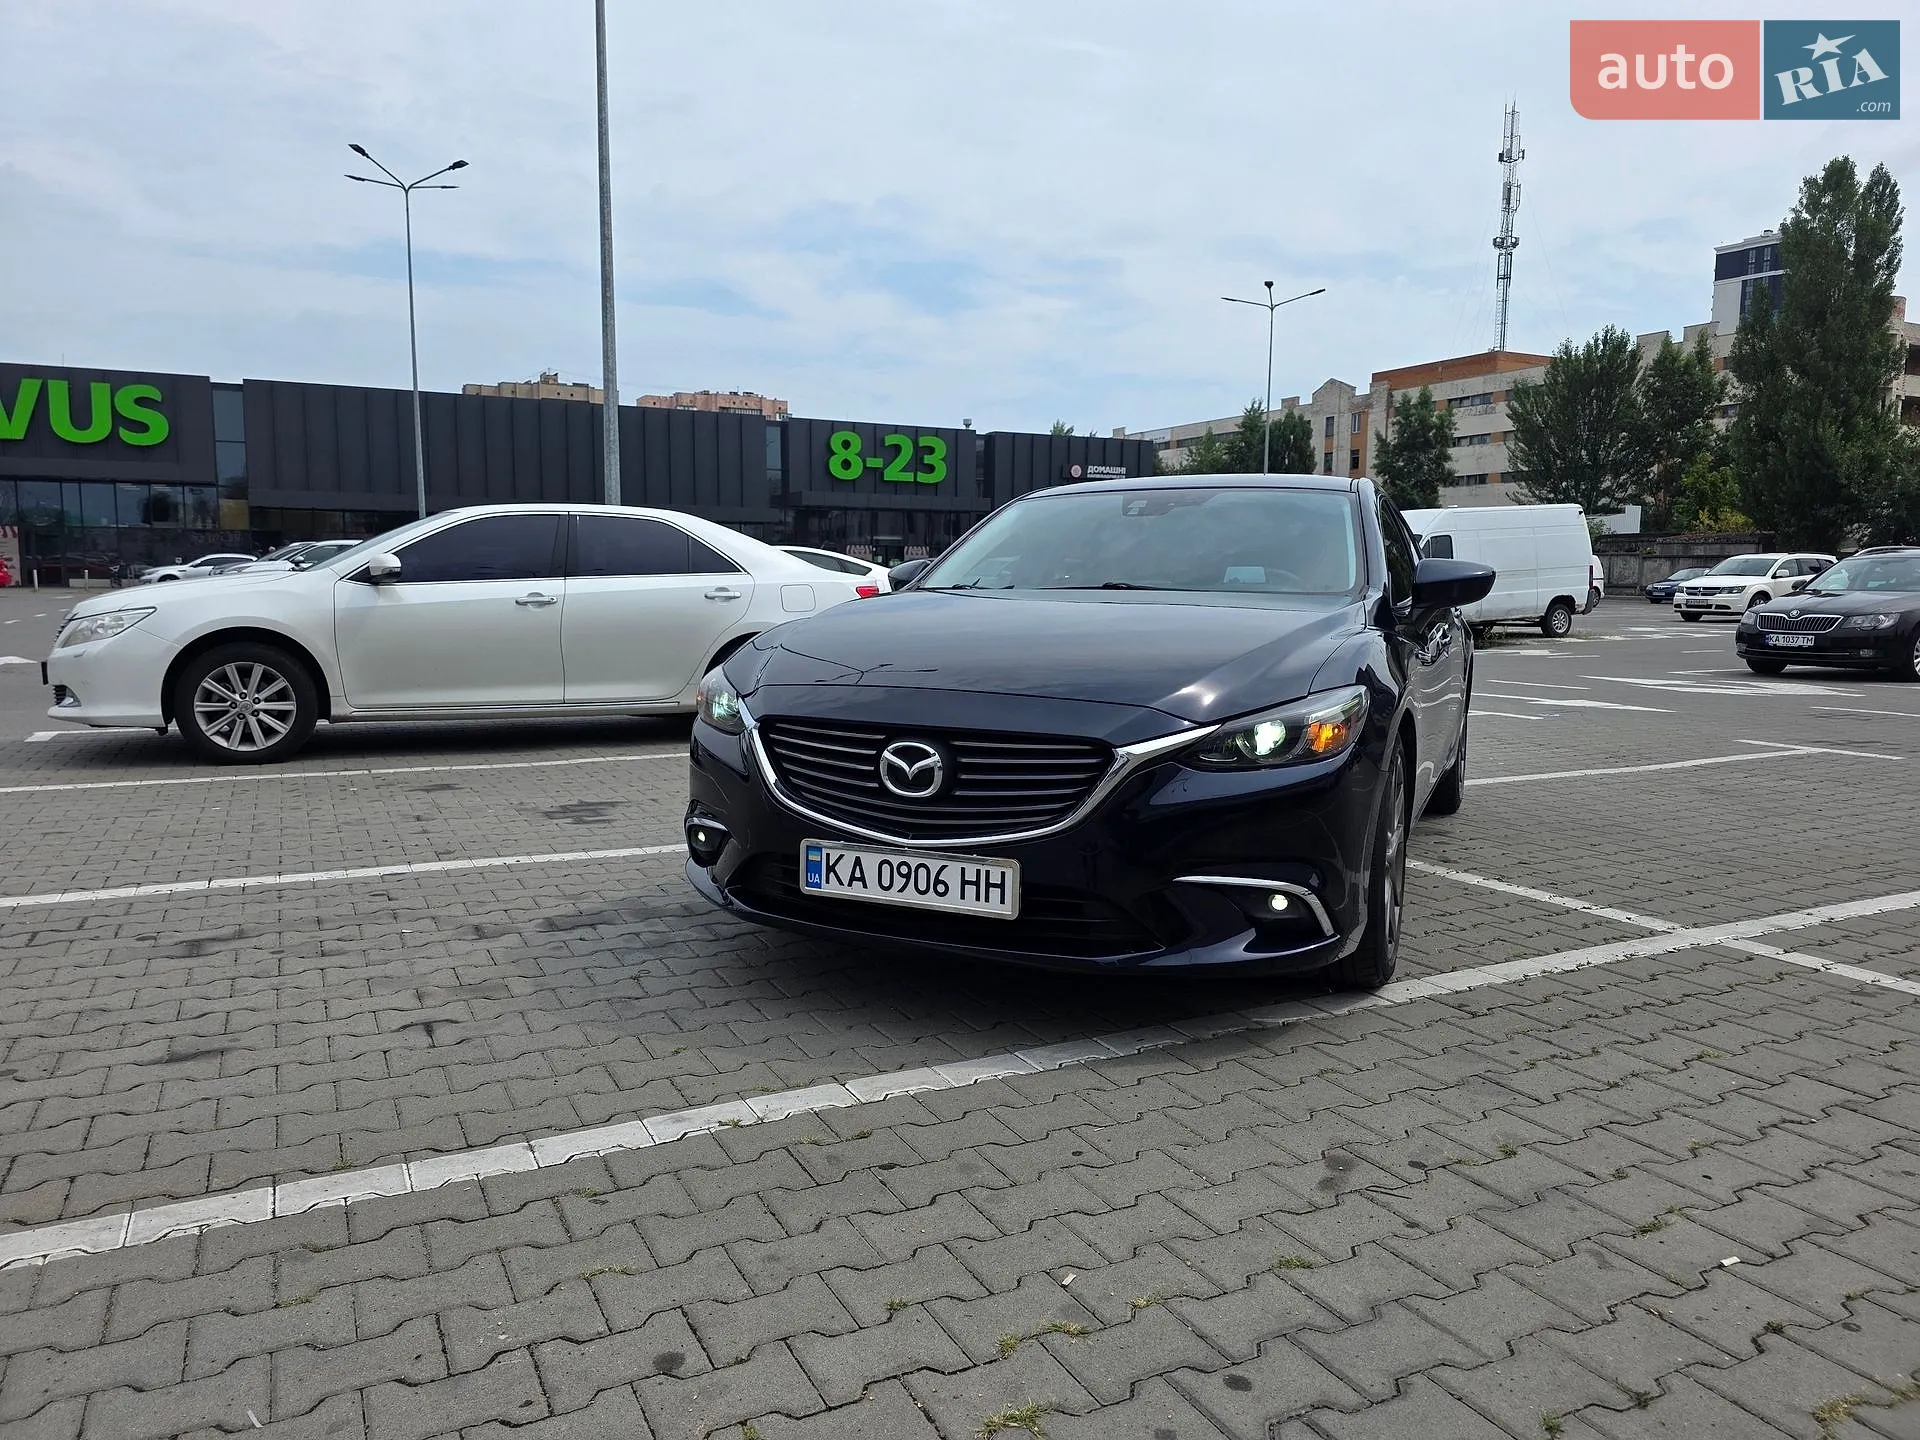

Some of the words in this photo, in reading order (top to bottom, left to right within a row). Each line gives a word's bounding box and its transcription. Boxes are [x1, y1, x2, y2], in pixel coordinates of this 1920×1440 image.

[829, 431, 947, 484] 8-23
[1087, 465, 1126, 475] ДОМАШНІ
[1769, 635, 1781, 644] KA
[1781, 635, 1801, 645] 1037
[1801, 636, 1814, 646] TM
[807, 872, 821, 884] UA
[825, 852, 868, 889] KA
[877, 858, 950, 898] 0906
[960, 866, 1006, 905] HH
